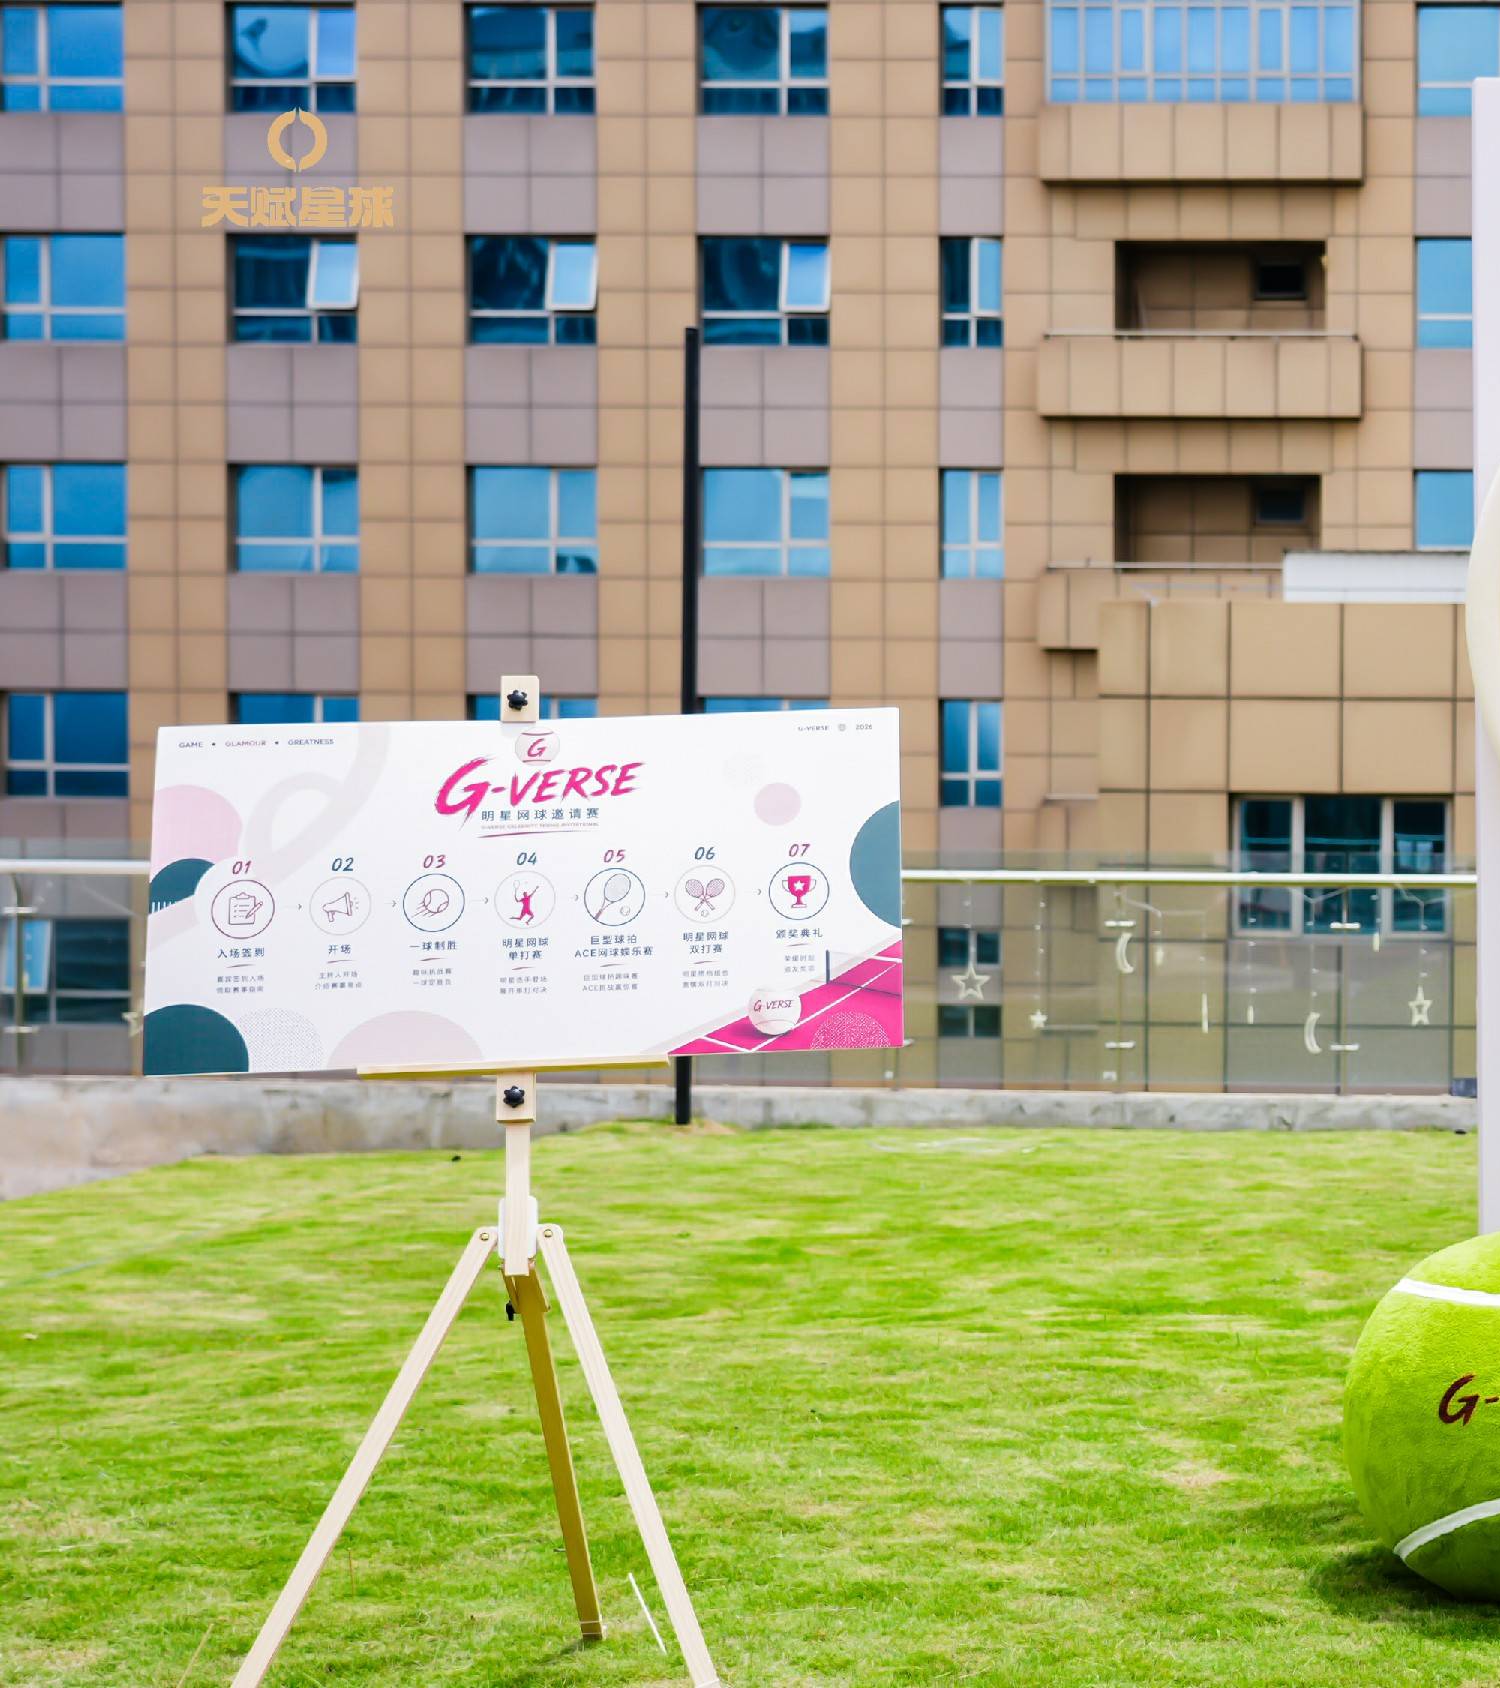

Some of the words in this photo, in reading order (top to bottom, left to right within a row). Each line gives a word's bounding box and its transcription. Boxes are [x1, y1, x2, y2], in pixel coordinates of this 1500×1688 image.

[287, 738, 335, 746] GREATNESS
[526, 738, 548, 758] G
[434, 754, 645, 831] G-VERSE
[481, 808, 600, 821] 明星网球邀请赛
[604, 849, 626, 863] 05
[694, 846, 716, 860] 06
[788, 843, 811, 857] 07
[331, 857, 354, 872] 02
[423, 855, 446, 869] 03
[516, 852, 537, 866] 04
[232, 861, 252, 875] 01
[590, 934, 637, 945] 巨型球拍
[682, 931, 729, 942] 明星网球
[776, 928, 823, 939] 颁奖典礼
[409, 940, 456, 951] 一球制胜
[502, 937, 549, 948] 明星网球
[217, 947, 265, 959] 入场签到
[328, 944, 351, 954] 开场
[508, 950, 542, 960] 单打赛
[574, 946, 653, 958] ACE网球娱乐赛
[689, 944, 723, 954] 双打赛
[753, 999, 793, 1012] GVERSE
